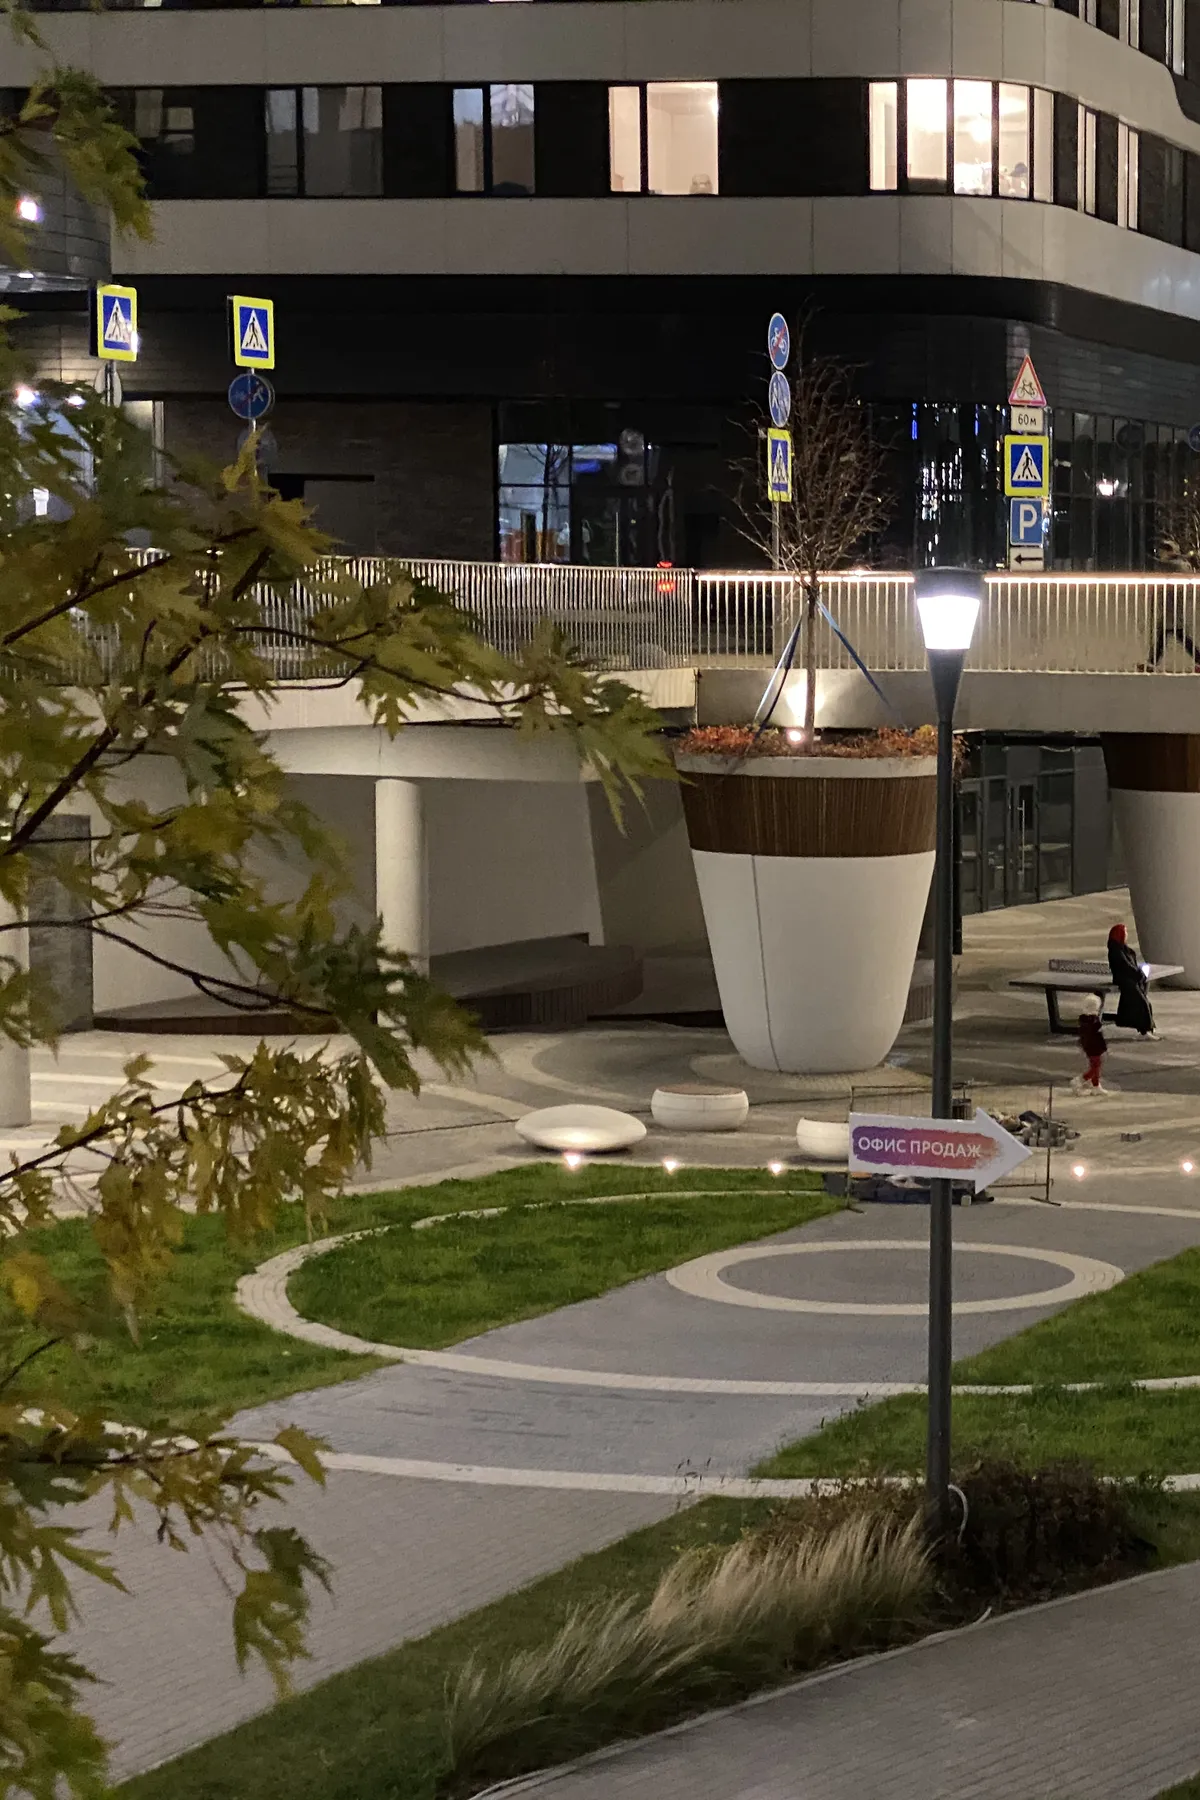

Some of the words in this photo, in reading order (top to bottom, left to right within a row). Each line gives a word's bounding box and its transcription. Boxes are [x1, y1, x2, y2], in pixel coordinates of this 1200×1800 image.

[1019, 503, 1038, 540] P
[857, 1136, 906, 1153] ОФИС
[910, 1140, 982, 1158] ПРОДАЖ
